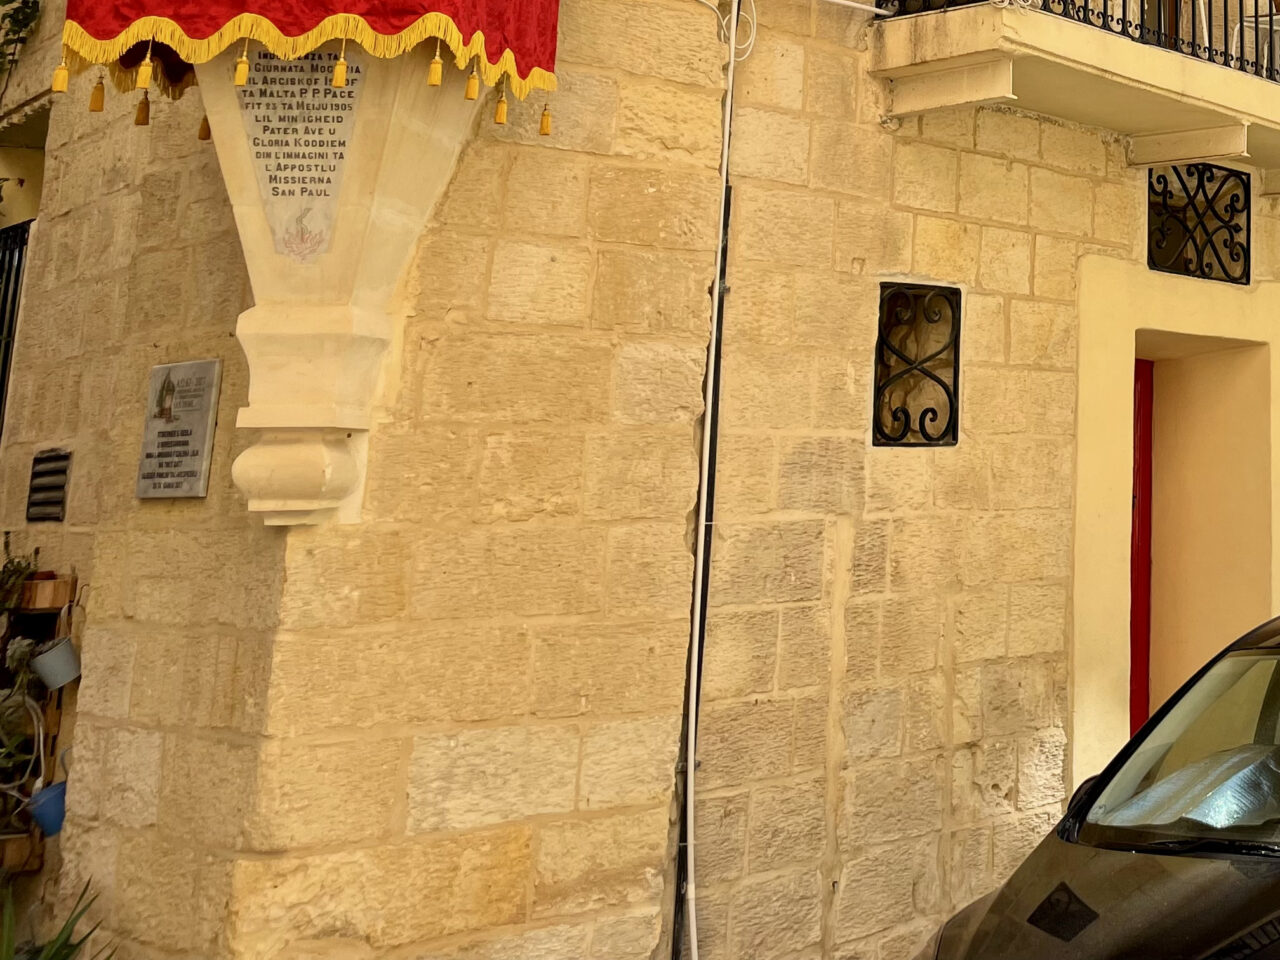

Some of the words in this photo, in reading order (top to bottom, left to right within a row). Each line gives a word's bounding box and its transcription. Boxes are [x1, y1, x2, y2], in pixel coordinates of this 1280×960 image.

[324, 77, 358, 87] ISOF
[241, 90, 255, 98] TA
[259, 88, 296, 98] MALTA
[323, 88, 354, 98] PACE
[245, 102, 262, 110] FIT
[281, 102, 294, 110] TA
[330, 103, 353, 111] 1905
[255, 115, 273, 123] LIL
[278, 115, 298, 123] MIN
[263, 125, 299, 135] PATER
[303, 126, 324, 135] AVE
[328, 127, 336, 135] U
[253, 137, 290, 147] GLORIA
[294, 137, 346, 147] KODDIEM
[255, 151, 272, 159] DIN
[333, 151, 345, 159] TA
[268, 174, 332, 184] MISSIERNA
[271, 186, 296, 196] SAN
[300, 186, 330, 197] PAUL
